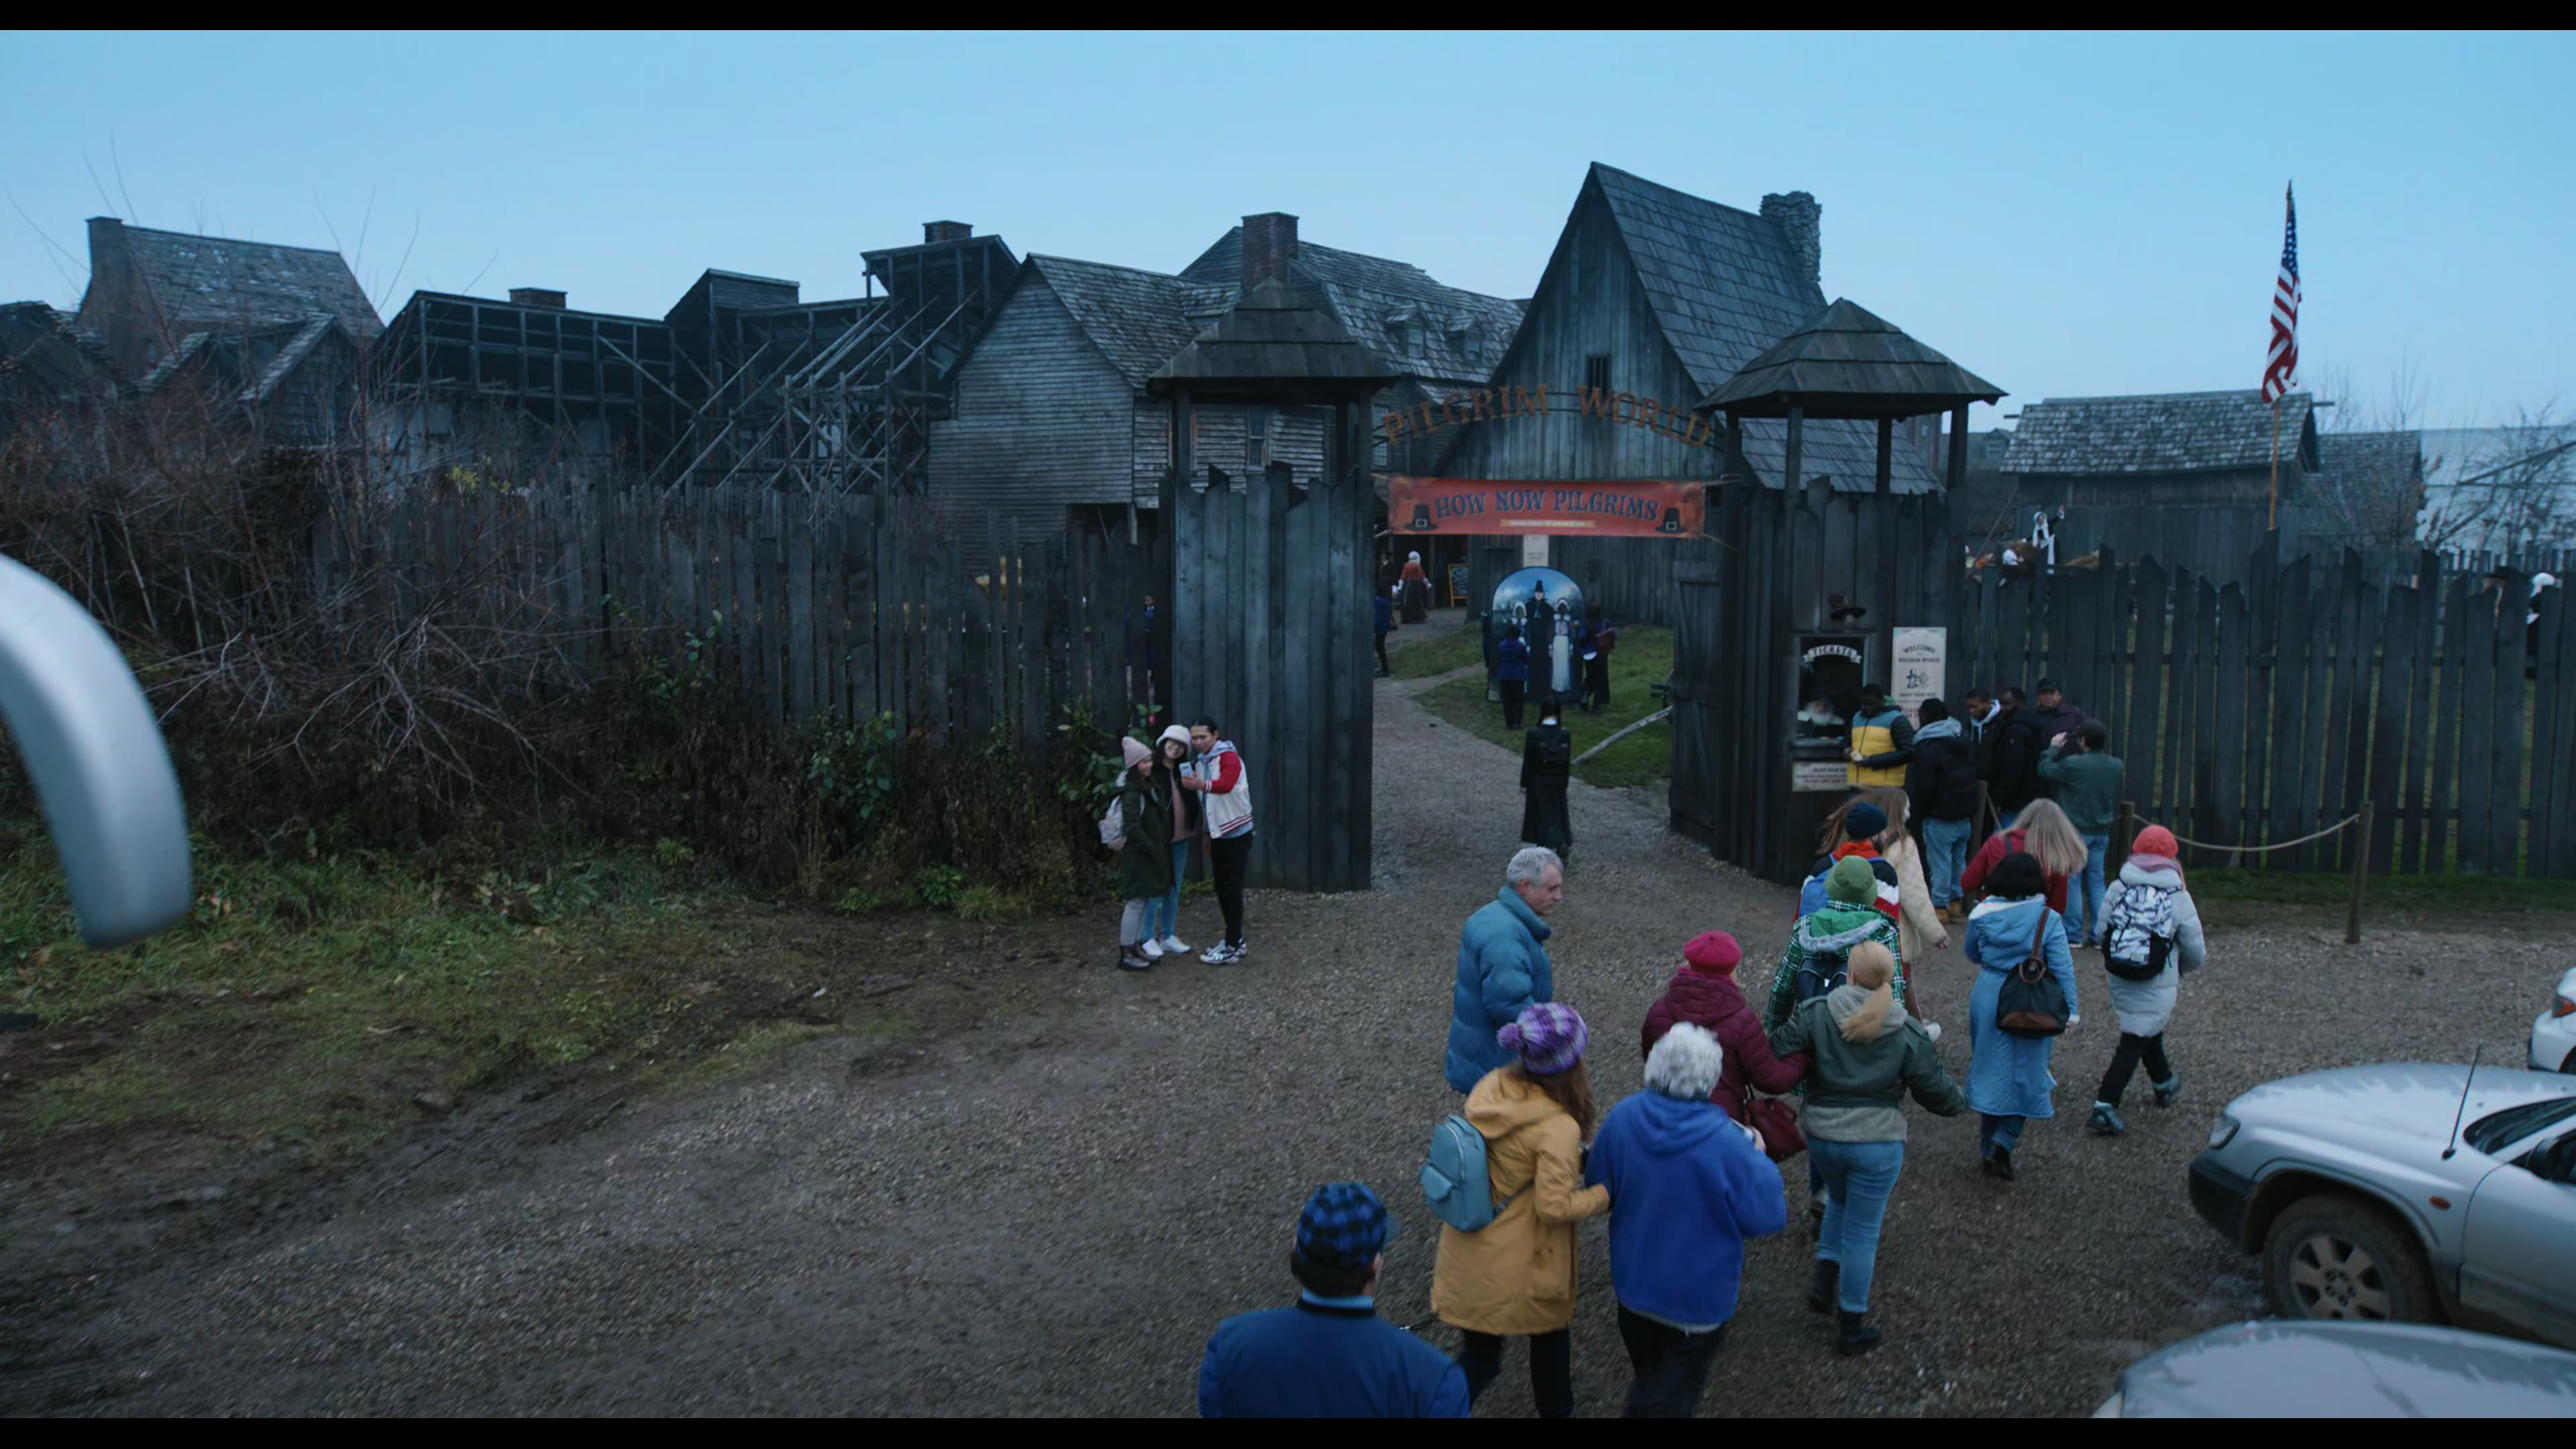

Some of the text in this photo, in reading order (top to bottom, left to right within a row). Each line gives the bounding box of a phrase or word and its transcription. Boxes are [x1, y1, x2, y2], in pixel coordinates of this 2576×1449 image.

[1383, 385, 1711, 447] PILGRIM WORLD
[1435, 489, 1659, 521] HOW NOW PILGRIMS
[1813, 645, 1852, 655] TICKETS
[1903, 644, 1935, 653] WELCOME
